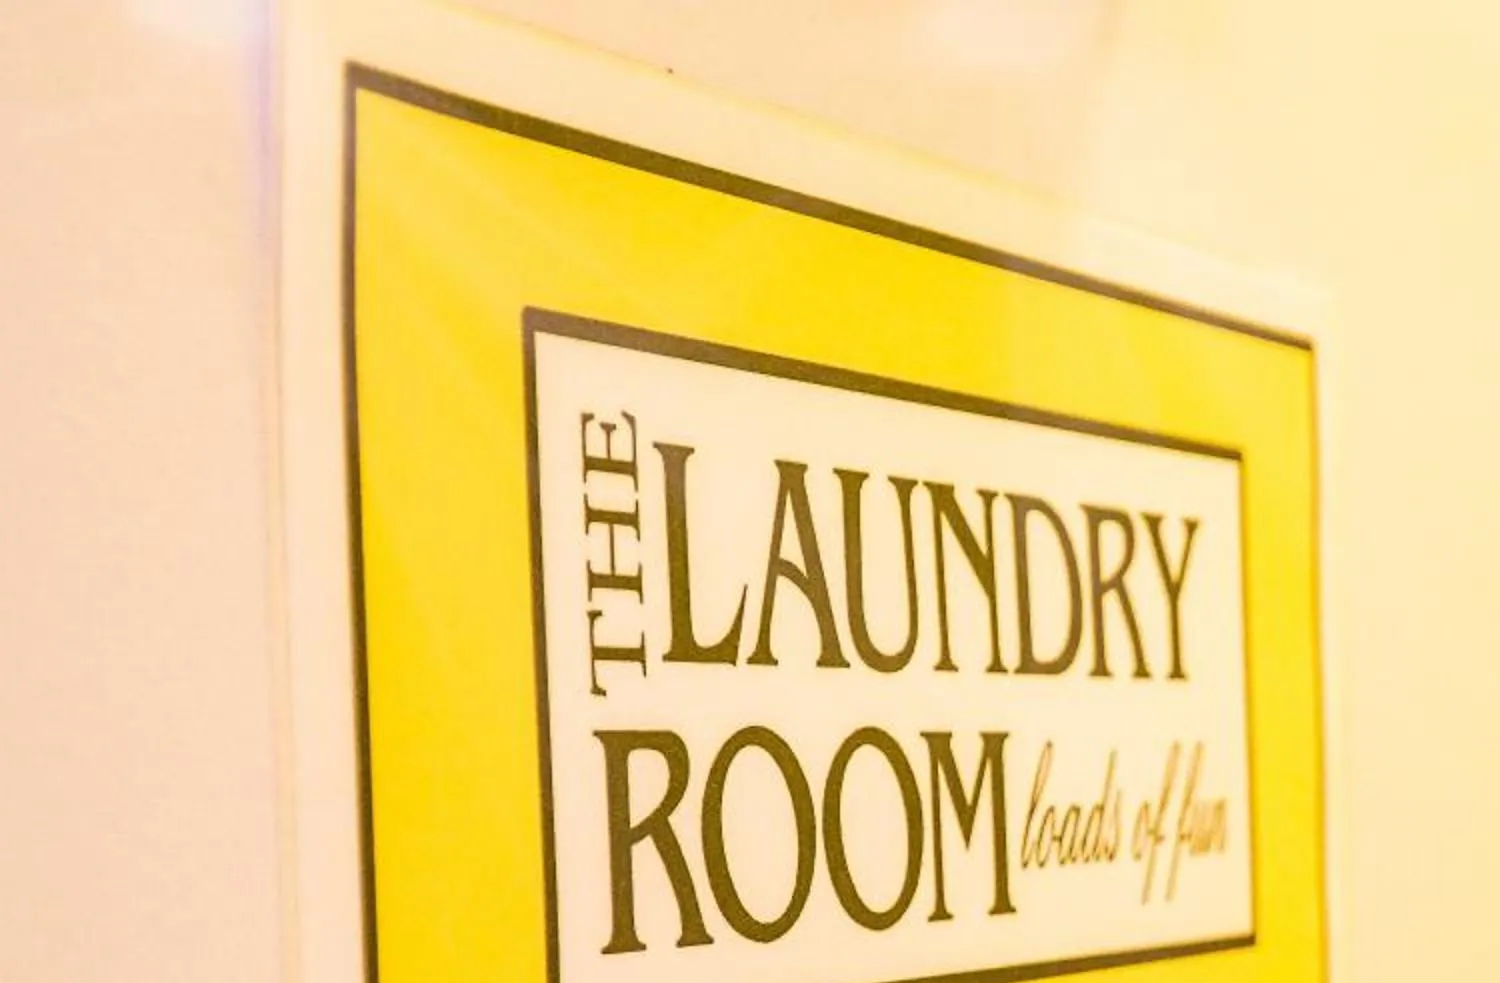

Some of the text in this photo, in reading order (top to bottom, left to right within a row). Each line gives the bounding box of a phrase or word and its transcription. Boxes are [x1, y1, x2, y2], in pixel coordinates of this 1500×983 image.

[580, 410, 647, 697] THE
[652, 441, 1200, 680] LAUNDRY
[592, 724, 1017, 955] ROOM
[1020, 740, 1229, 906] loads of fun
